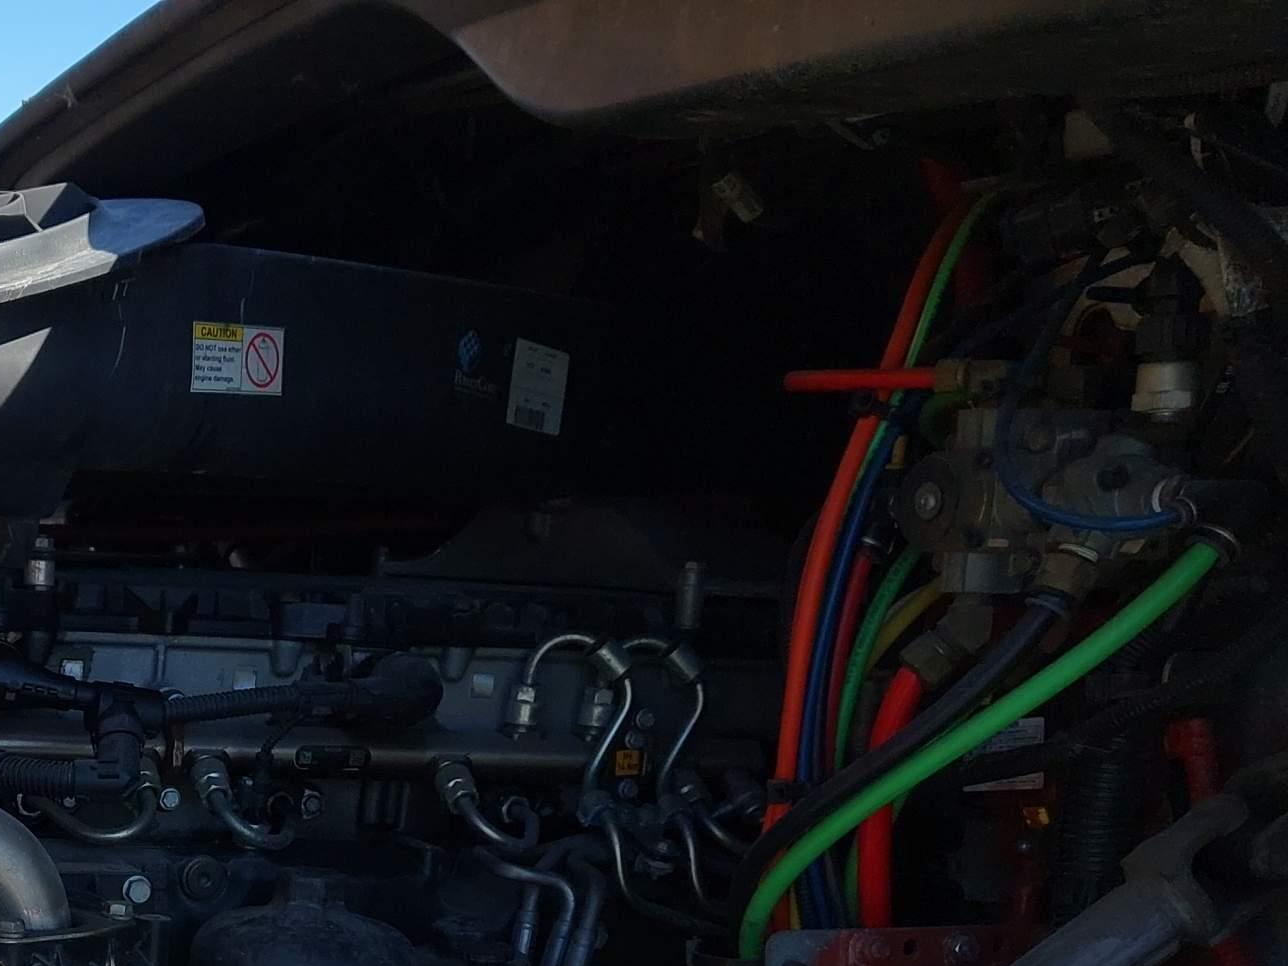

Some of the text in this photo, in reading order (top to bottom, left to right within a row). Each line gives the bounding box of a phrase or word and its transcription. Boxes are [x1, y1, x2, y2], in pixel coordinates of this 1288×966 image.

[201, 326, 237, 339] CAUTION
[195, 343, 205, 351] DO
[205, 344, 217, 352] NOT
